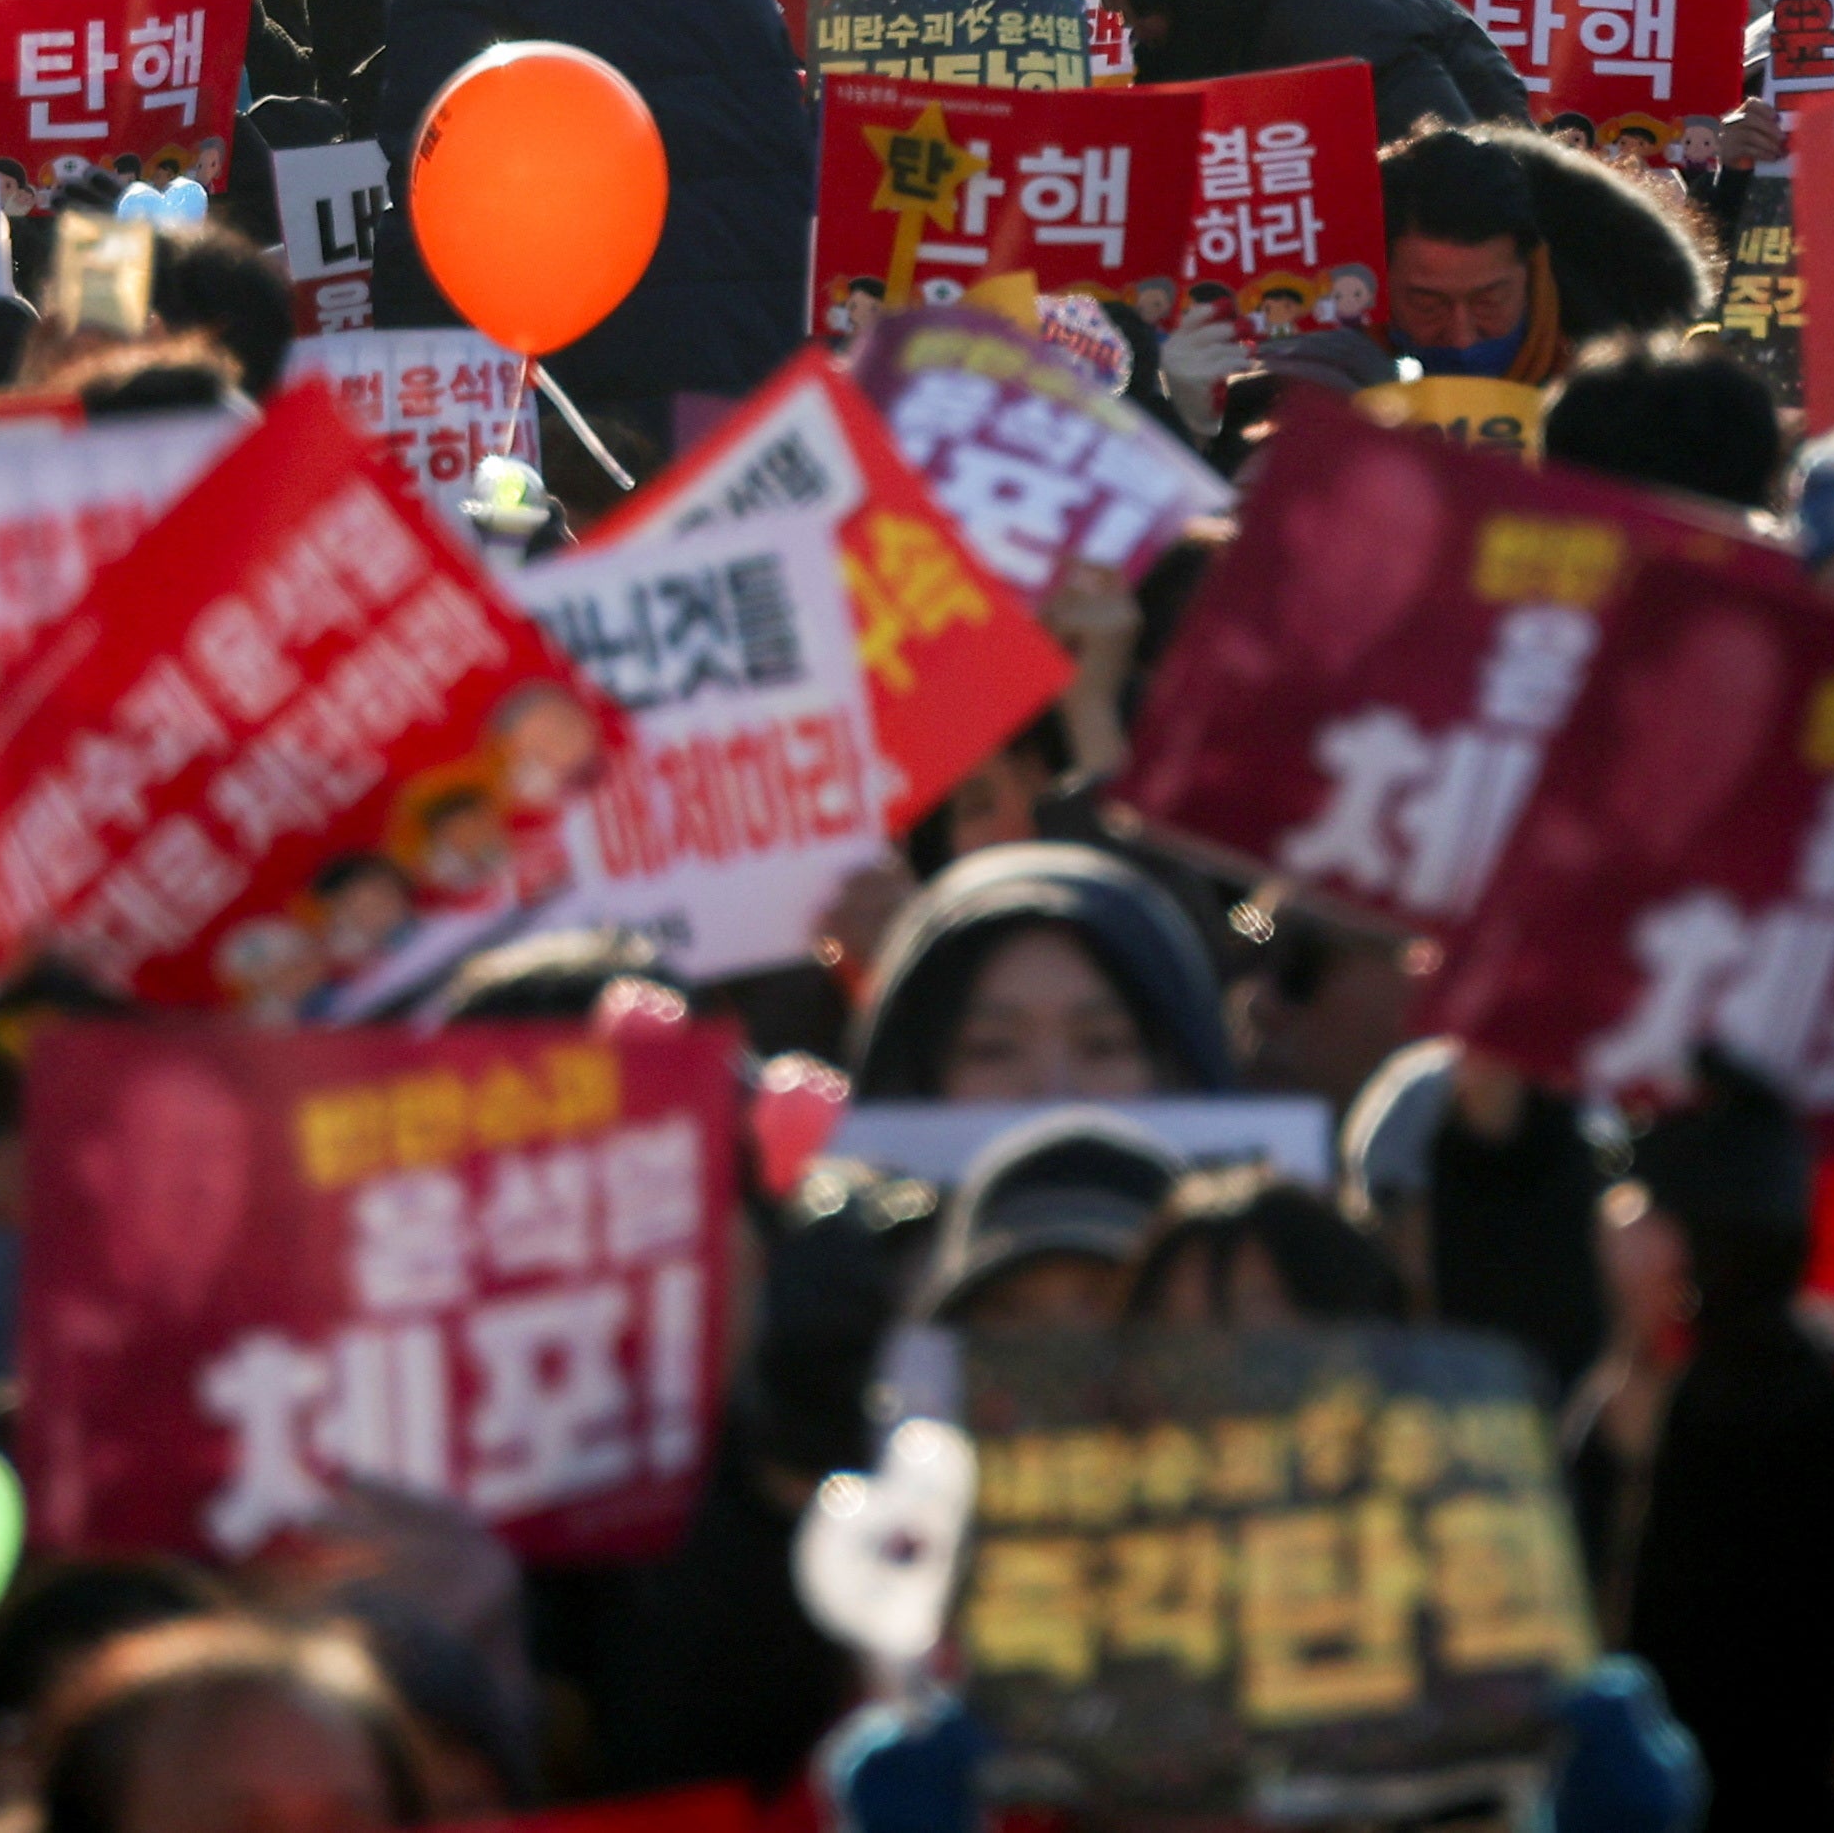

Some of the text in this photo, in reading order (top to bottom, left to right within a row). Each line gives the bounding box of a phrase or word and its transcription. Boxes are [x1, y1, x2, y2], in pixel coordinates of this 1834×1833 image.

[17, 6, 208, 141] 탄핵
[817, 8, 1085, 55] 내란수괴 윤석열
[197, 1263, 705, 1561] 체포!
